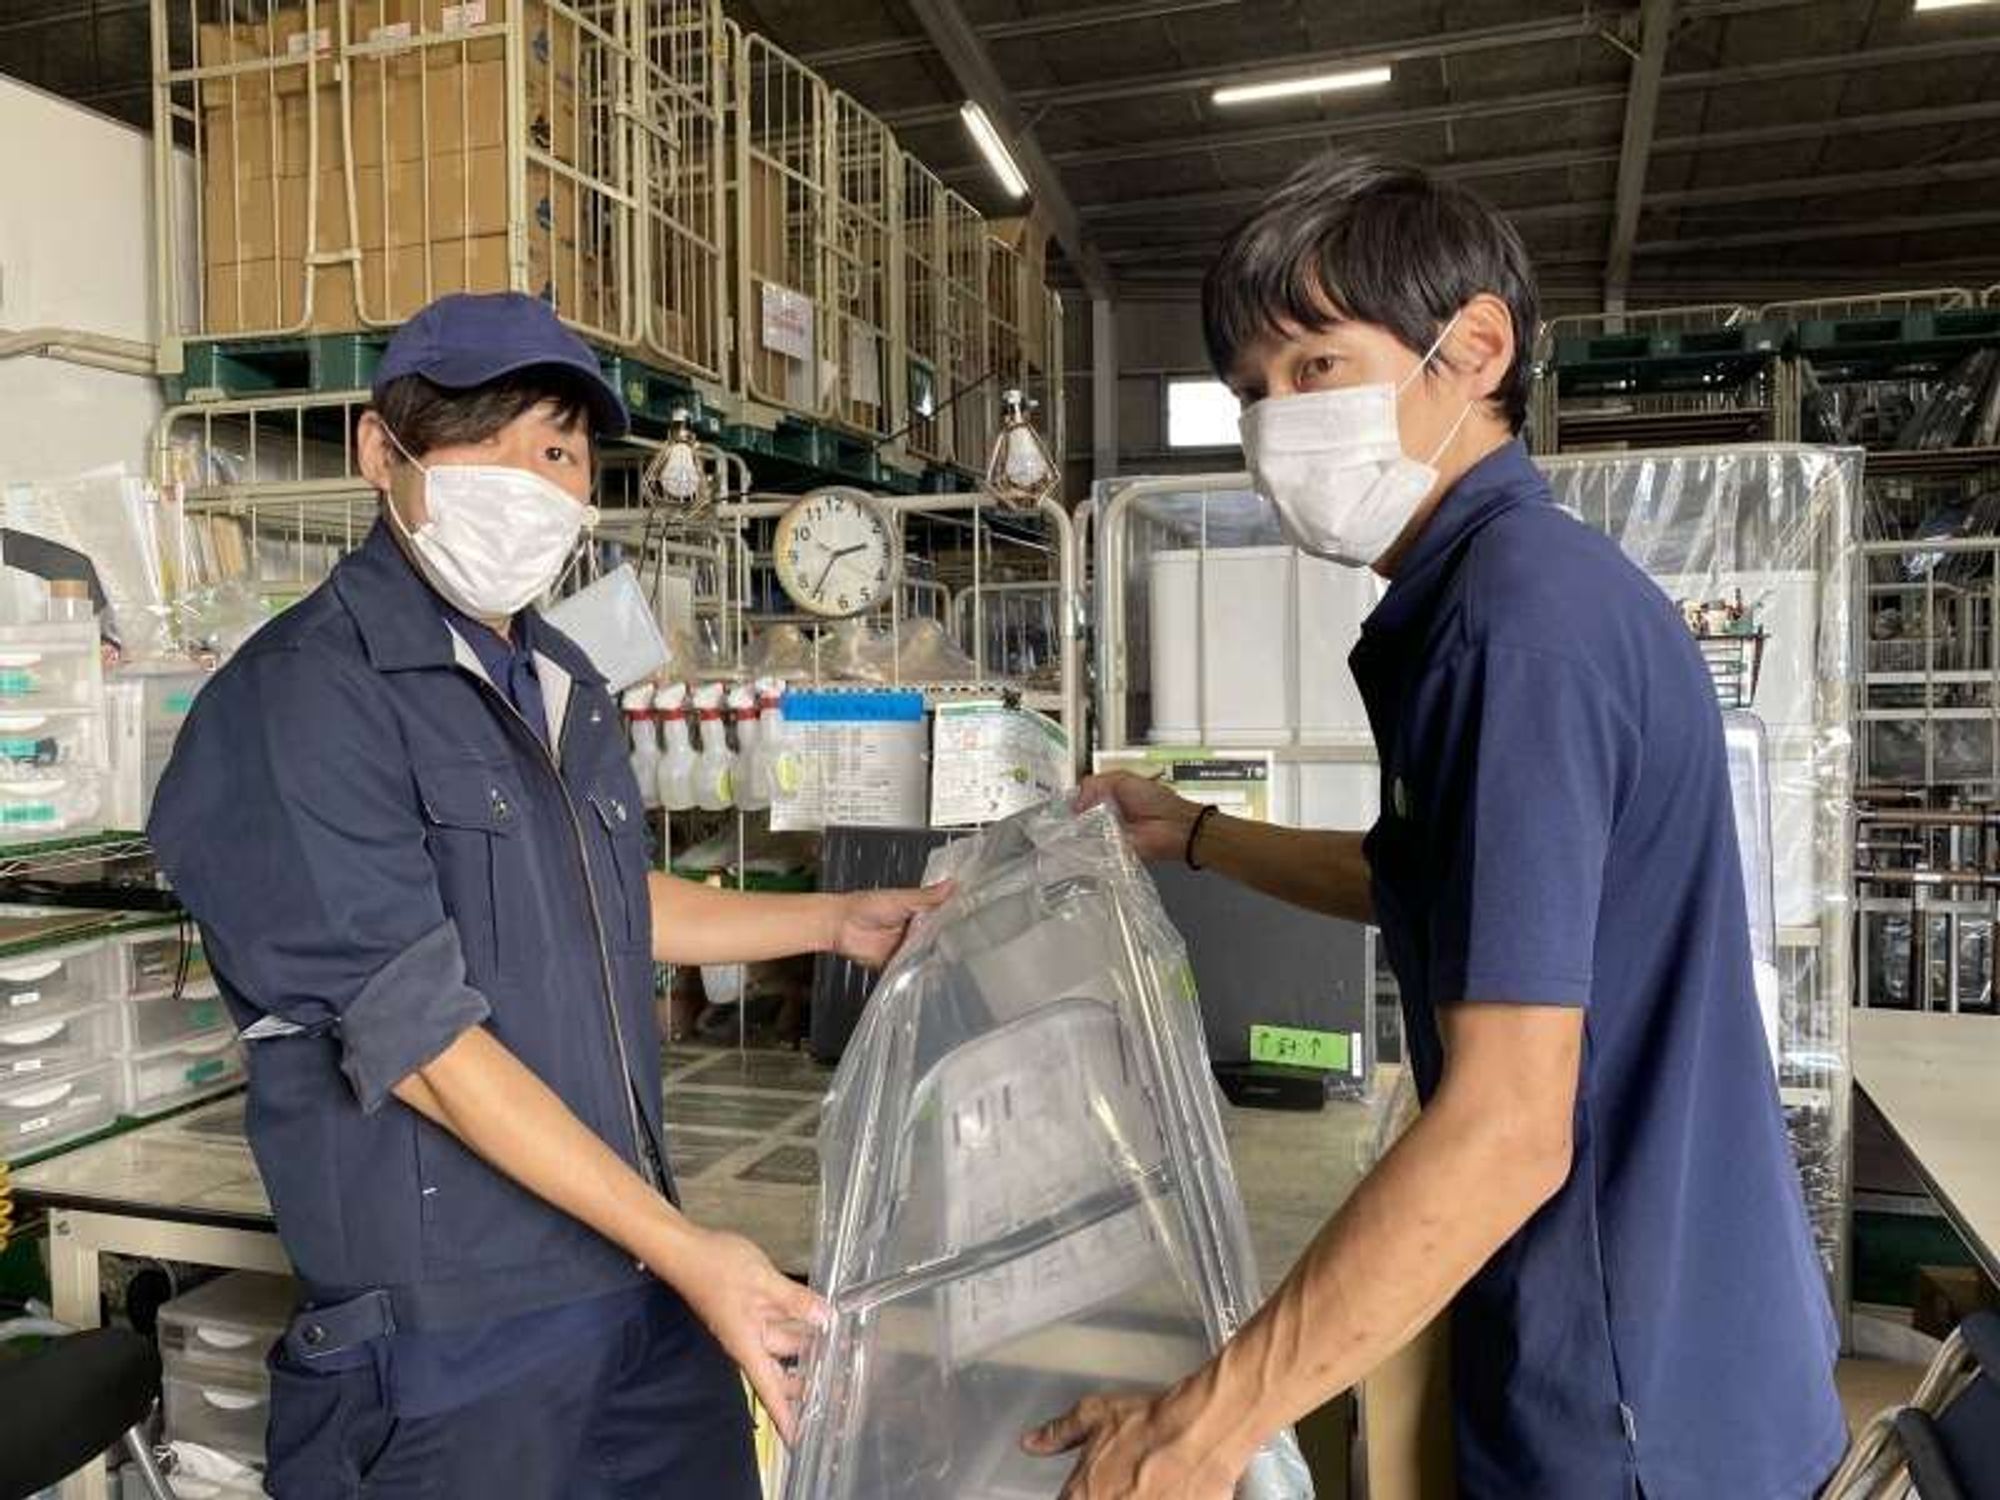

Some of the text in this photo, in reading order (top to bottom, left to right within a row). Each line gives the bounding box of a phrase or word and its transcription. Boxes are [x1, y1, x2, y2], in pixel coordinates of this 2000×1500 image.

[826, 495, 844, 513] 12
[807, 506, 822, 521] 11
[871, 517, 881, 534] 2
[794, 526, 811, 541] 10
[860, 586, 872, 601] 5
[838, 594, 850, 610] 6
